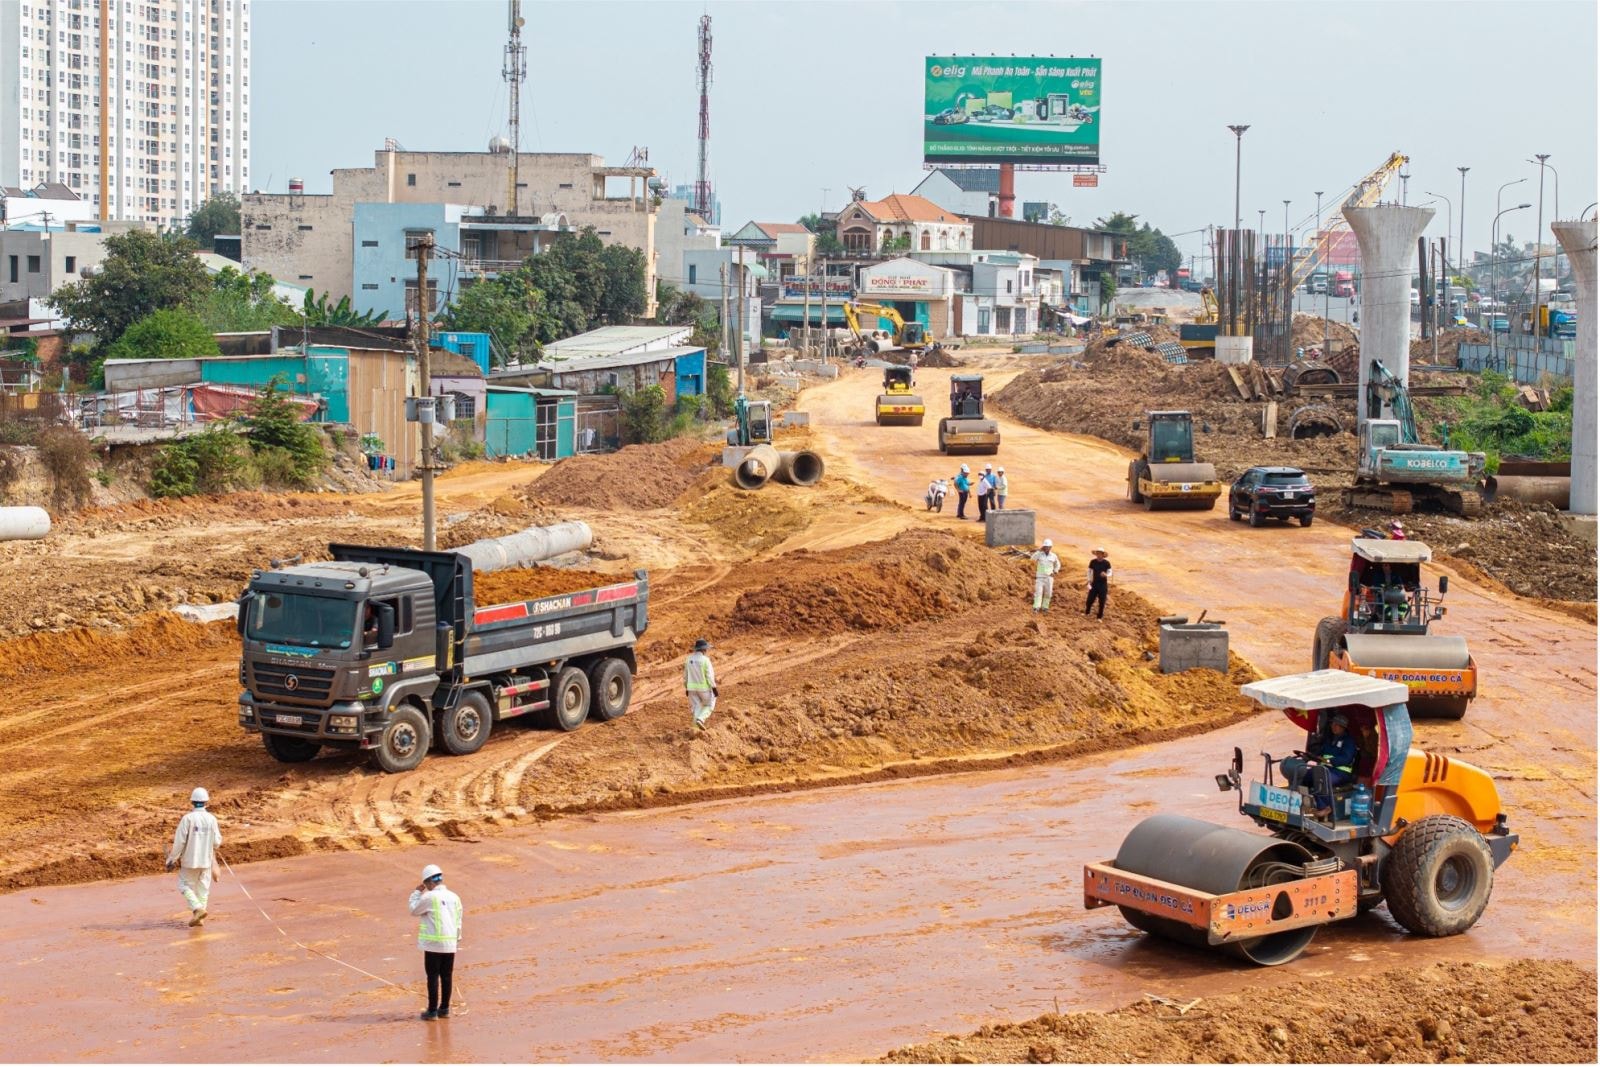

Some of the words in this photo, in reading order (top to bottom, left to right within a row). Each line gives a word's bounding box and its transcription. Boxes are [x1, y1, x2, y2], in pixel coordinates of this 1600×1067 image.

[1407, 459, 1448, 468] KOBELCO
[539, 596, 572, 613] SHACMAN
[1269, 791, 1302, 808] DEOCA
